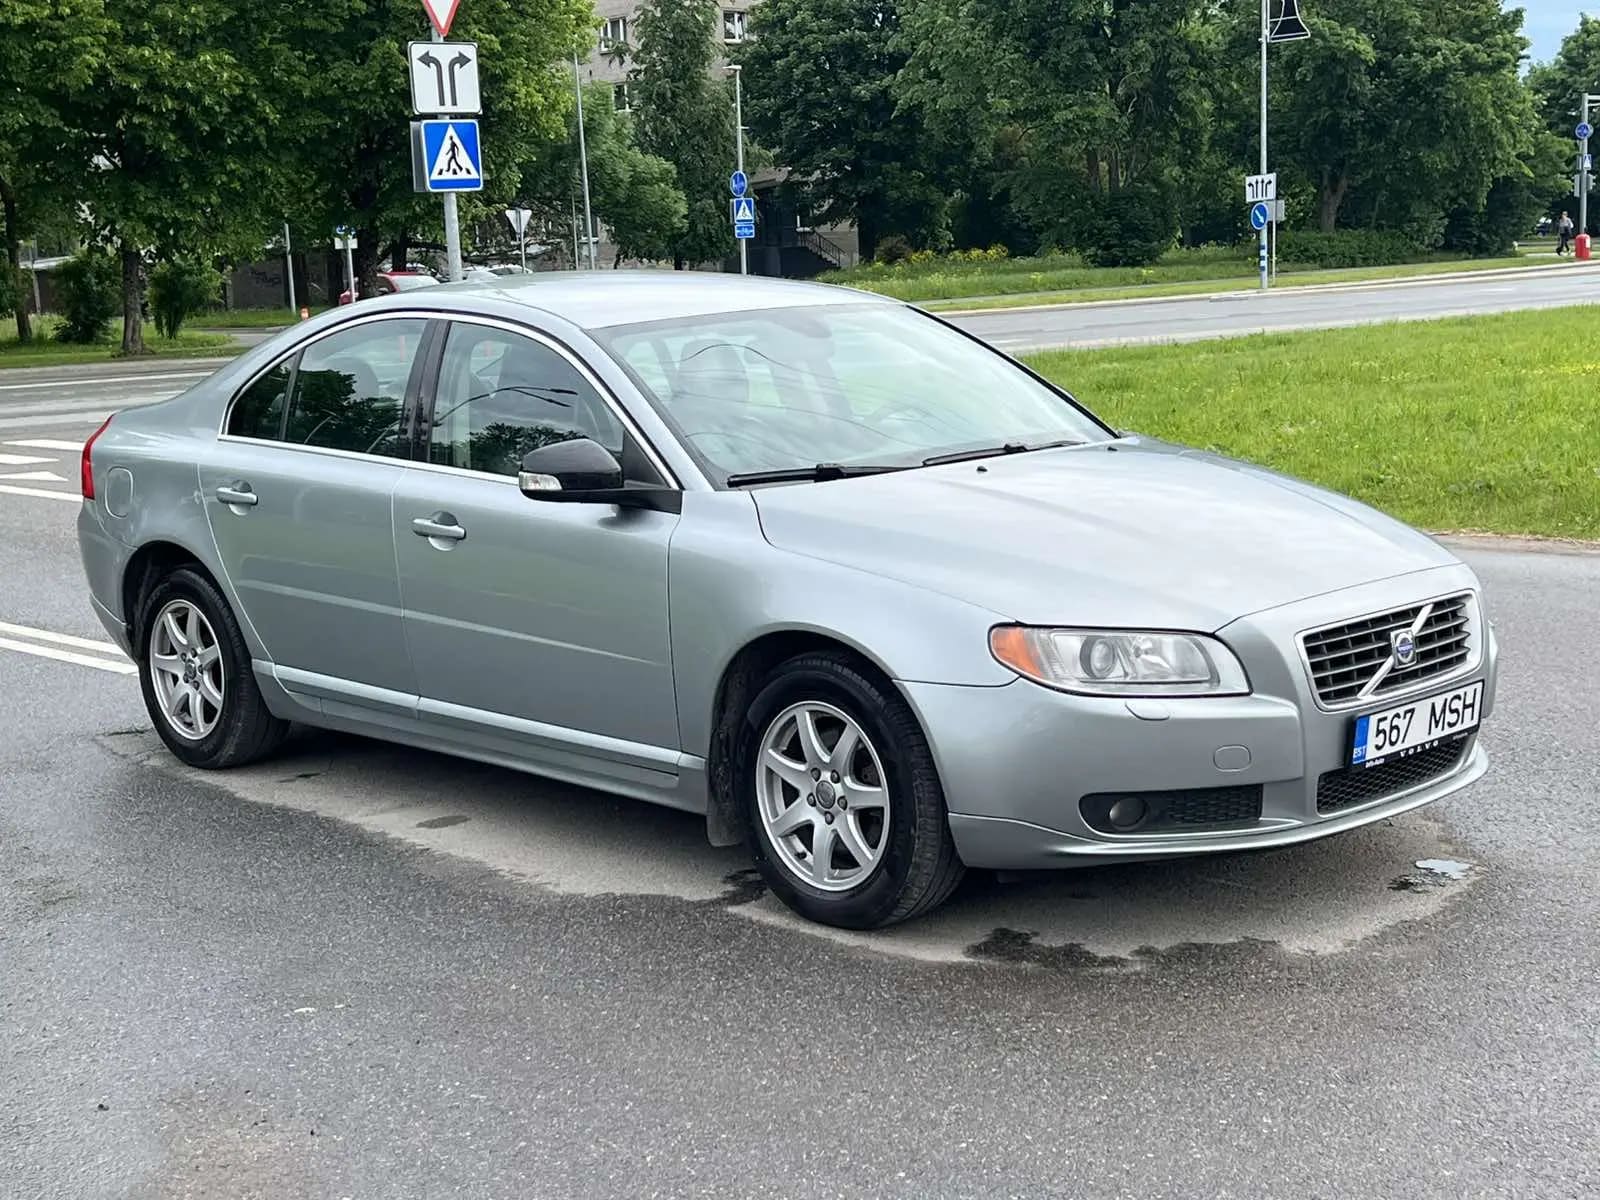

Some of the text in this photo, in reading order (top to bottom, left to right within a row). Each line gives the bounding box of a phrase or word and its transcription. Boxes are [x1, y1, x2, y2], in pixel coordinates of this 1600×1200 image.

[1374, 688, 1477, 751] 567 MSH
[1353, 746, 1367, 759] EST
[1400, 740, 1439, 757] VOLVO
